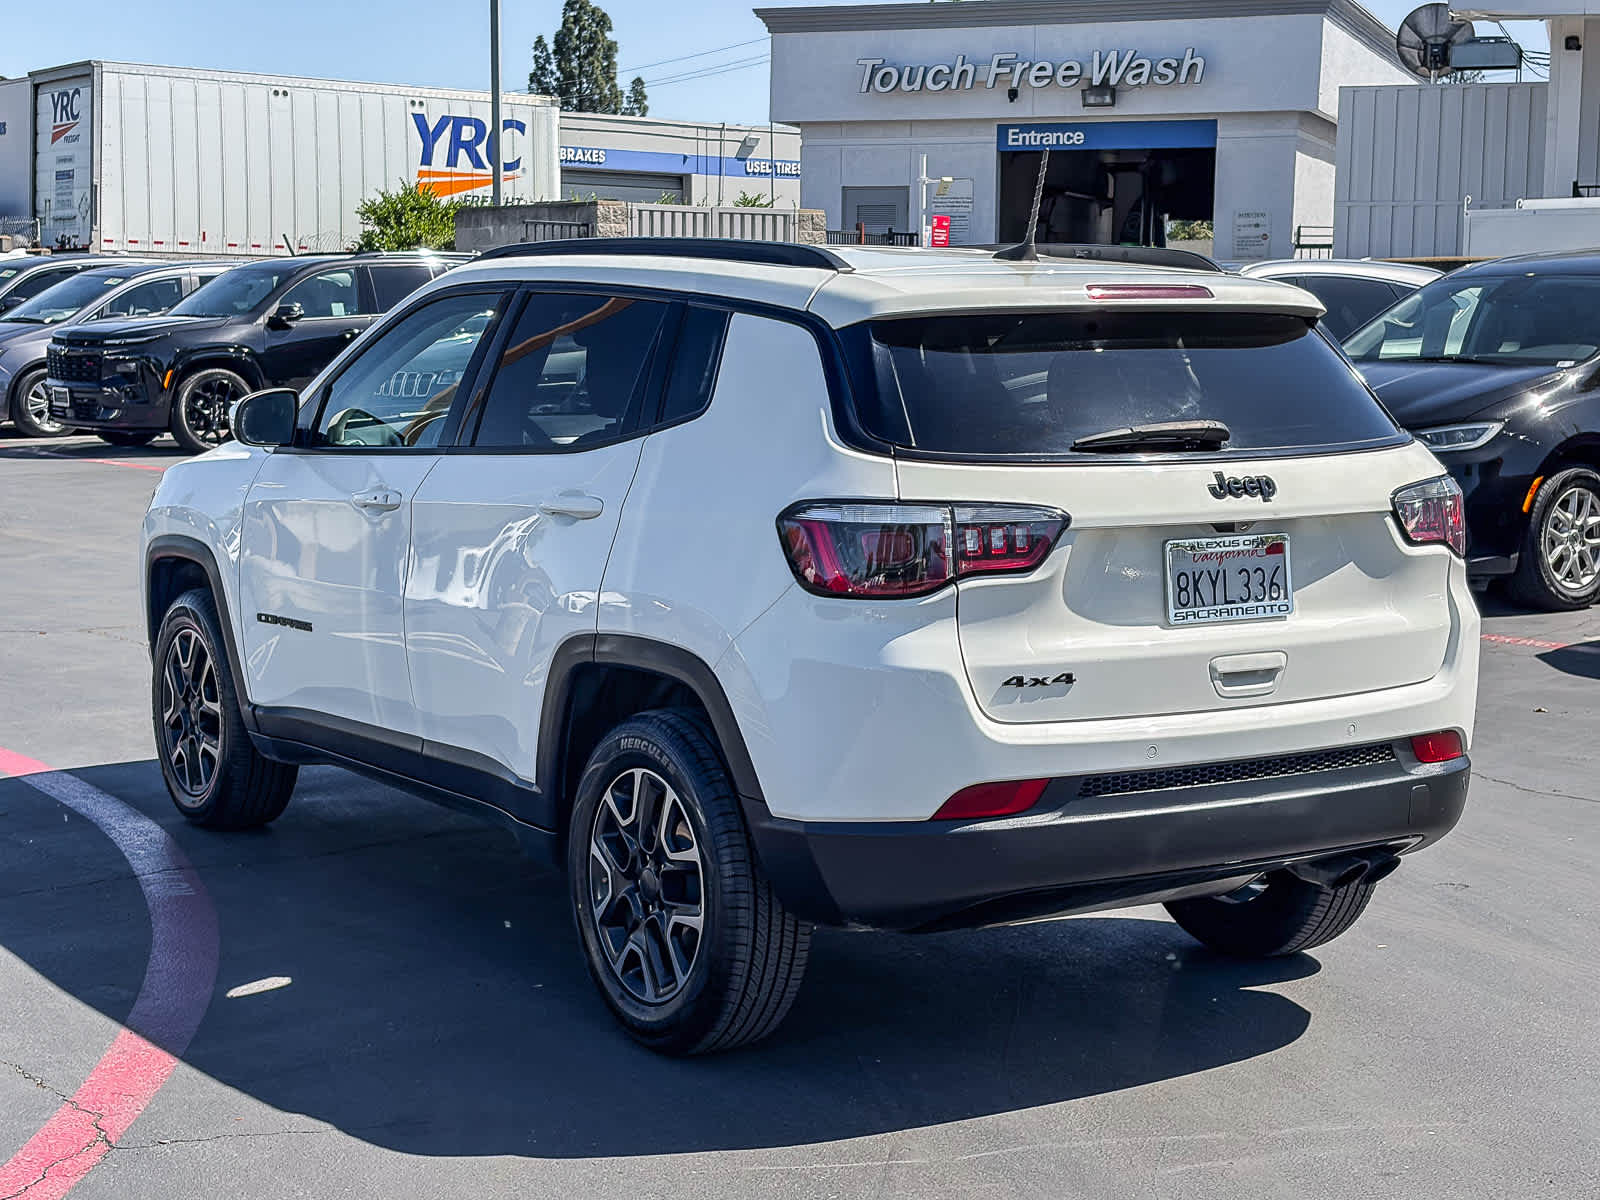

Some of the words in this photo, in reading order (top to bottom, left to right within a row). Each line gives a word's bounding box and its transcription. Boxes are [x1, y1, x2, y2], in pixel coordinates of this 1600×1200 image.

[857, 55, 975, 93] Touch
[985, 53, 1082, 89] Free
[1091, 48, 1206, 86] Wash
[51, 88, 80, 123] YRC
[411, 113, 526, 172] YRC
[1008, 128, 1084, 146] Entrance
[560, 147, 606, 162] BRAKES
[463, 194, 524, 207] FREHT
[1207, 471, 1277, 502] Jeep
[1196, 539, 1240, 550] LEXUS
[1176, 565, 1282, 607] 8KYL336
[1174, 603, 1290, 622] SACRAMENTO
[1001, 672, 1077, 688] 4x4
[620, 737, 678, 776] HERCULES
